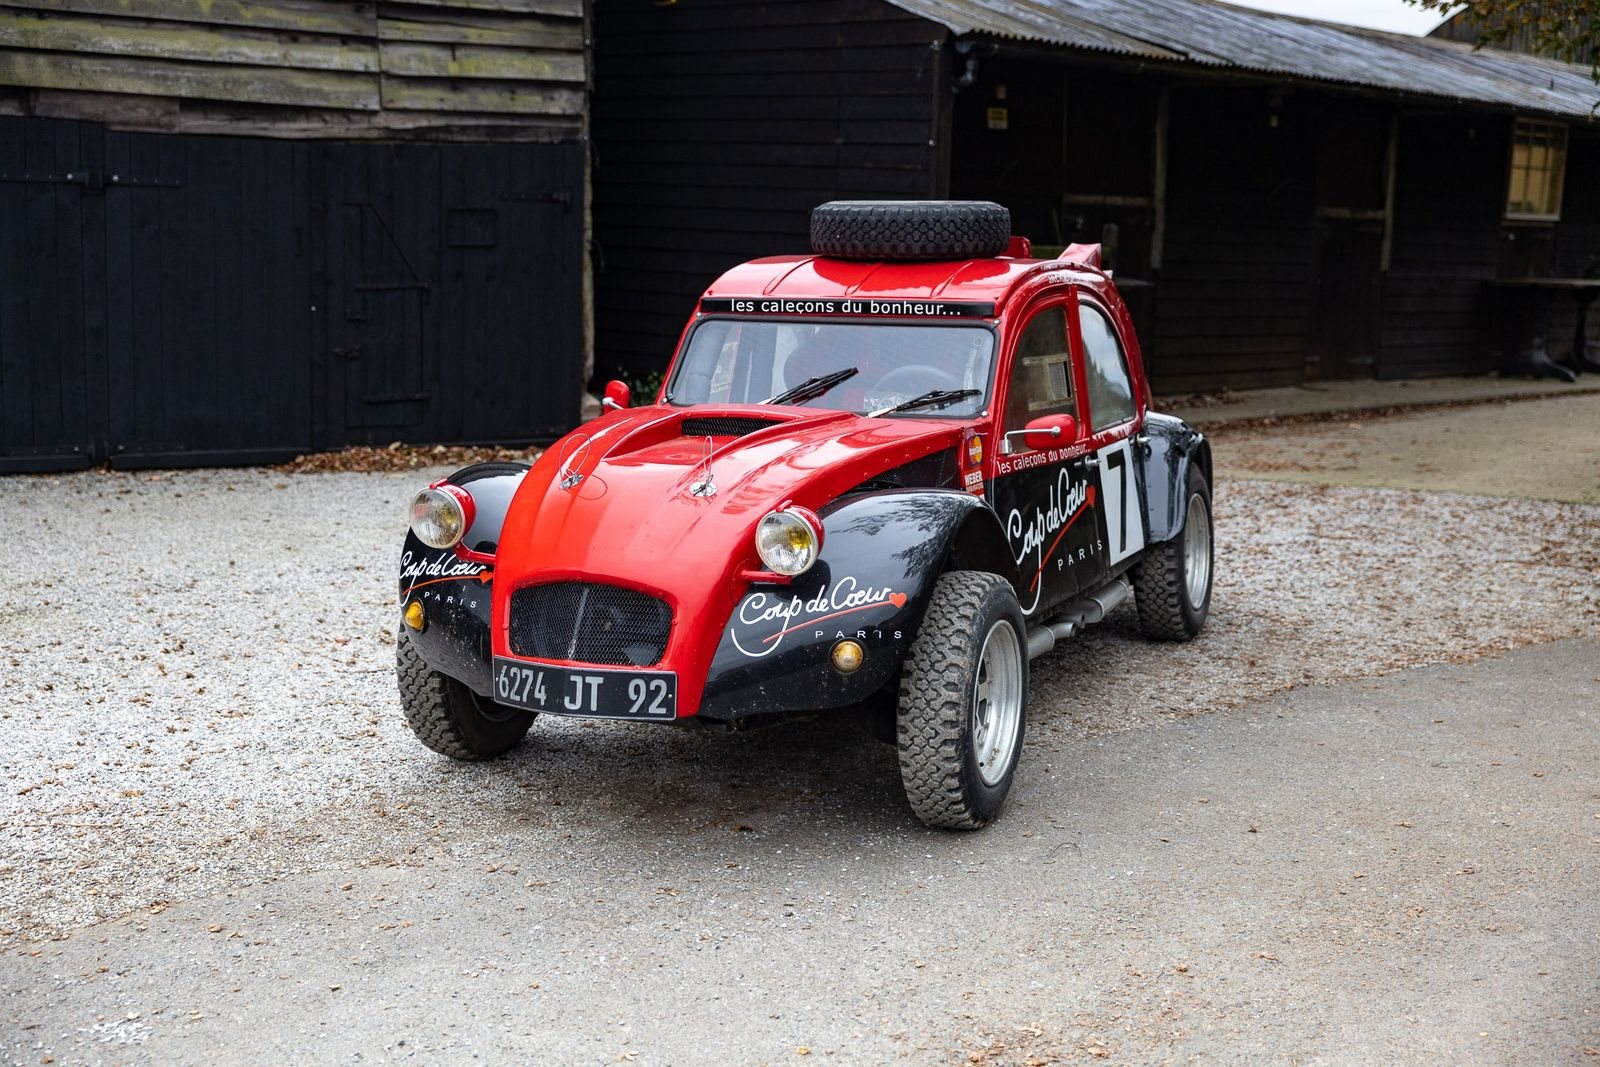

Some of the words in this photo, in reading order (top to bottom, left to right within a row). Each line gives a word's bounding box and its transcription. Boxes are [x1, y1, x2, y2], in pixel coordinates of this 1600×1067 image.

[731, 298, 754, 312] les
[761, 299, 835, 315] caleçons
[841, 300, 862, 313] du
[996, 460, 1012, 475] les
[1013, 452, 1047, 471] caleçons
[1048, 450, 1058, 462] du
[1046, 484, 1060, 534] de
[1105, 447, 1127, 554] 7
[426, 552, 443, 577] de
[1057, 539, 1103, 571] PARIS
[424, 591, 477, 609] PARIS
[806, 584, 830, 613] de
[814, 630, 903, 640] PARIS
[499, 665, 547, 706] 6274
[564, 674, 604, 712] JT
[628, 678, 668, 714] 92
